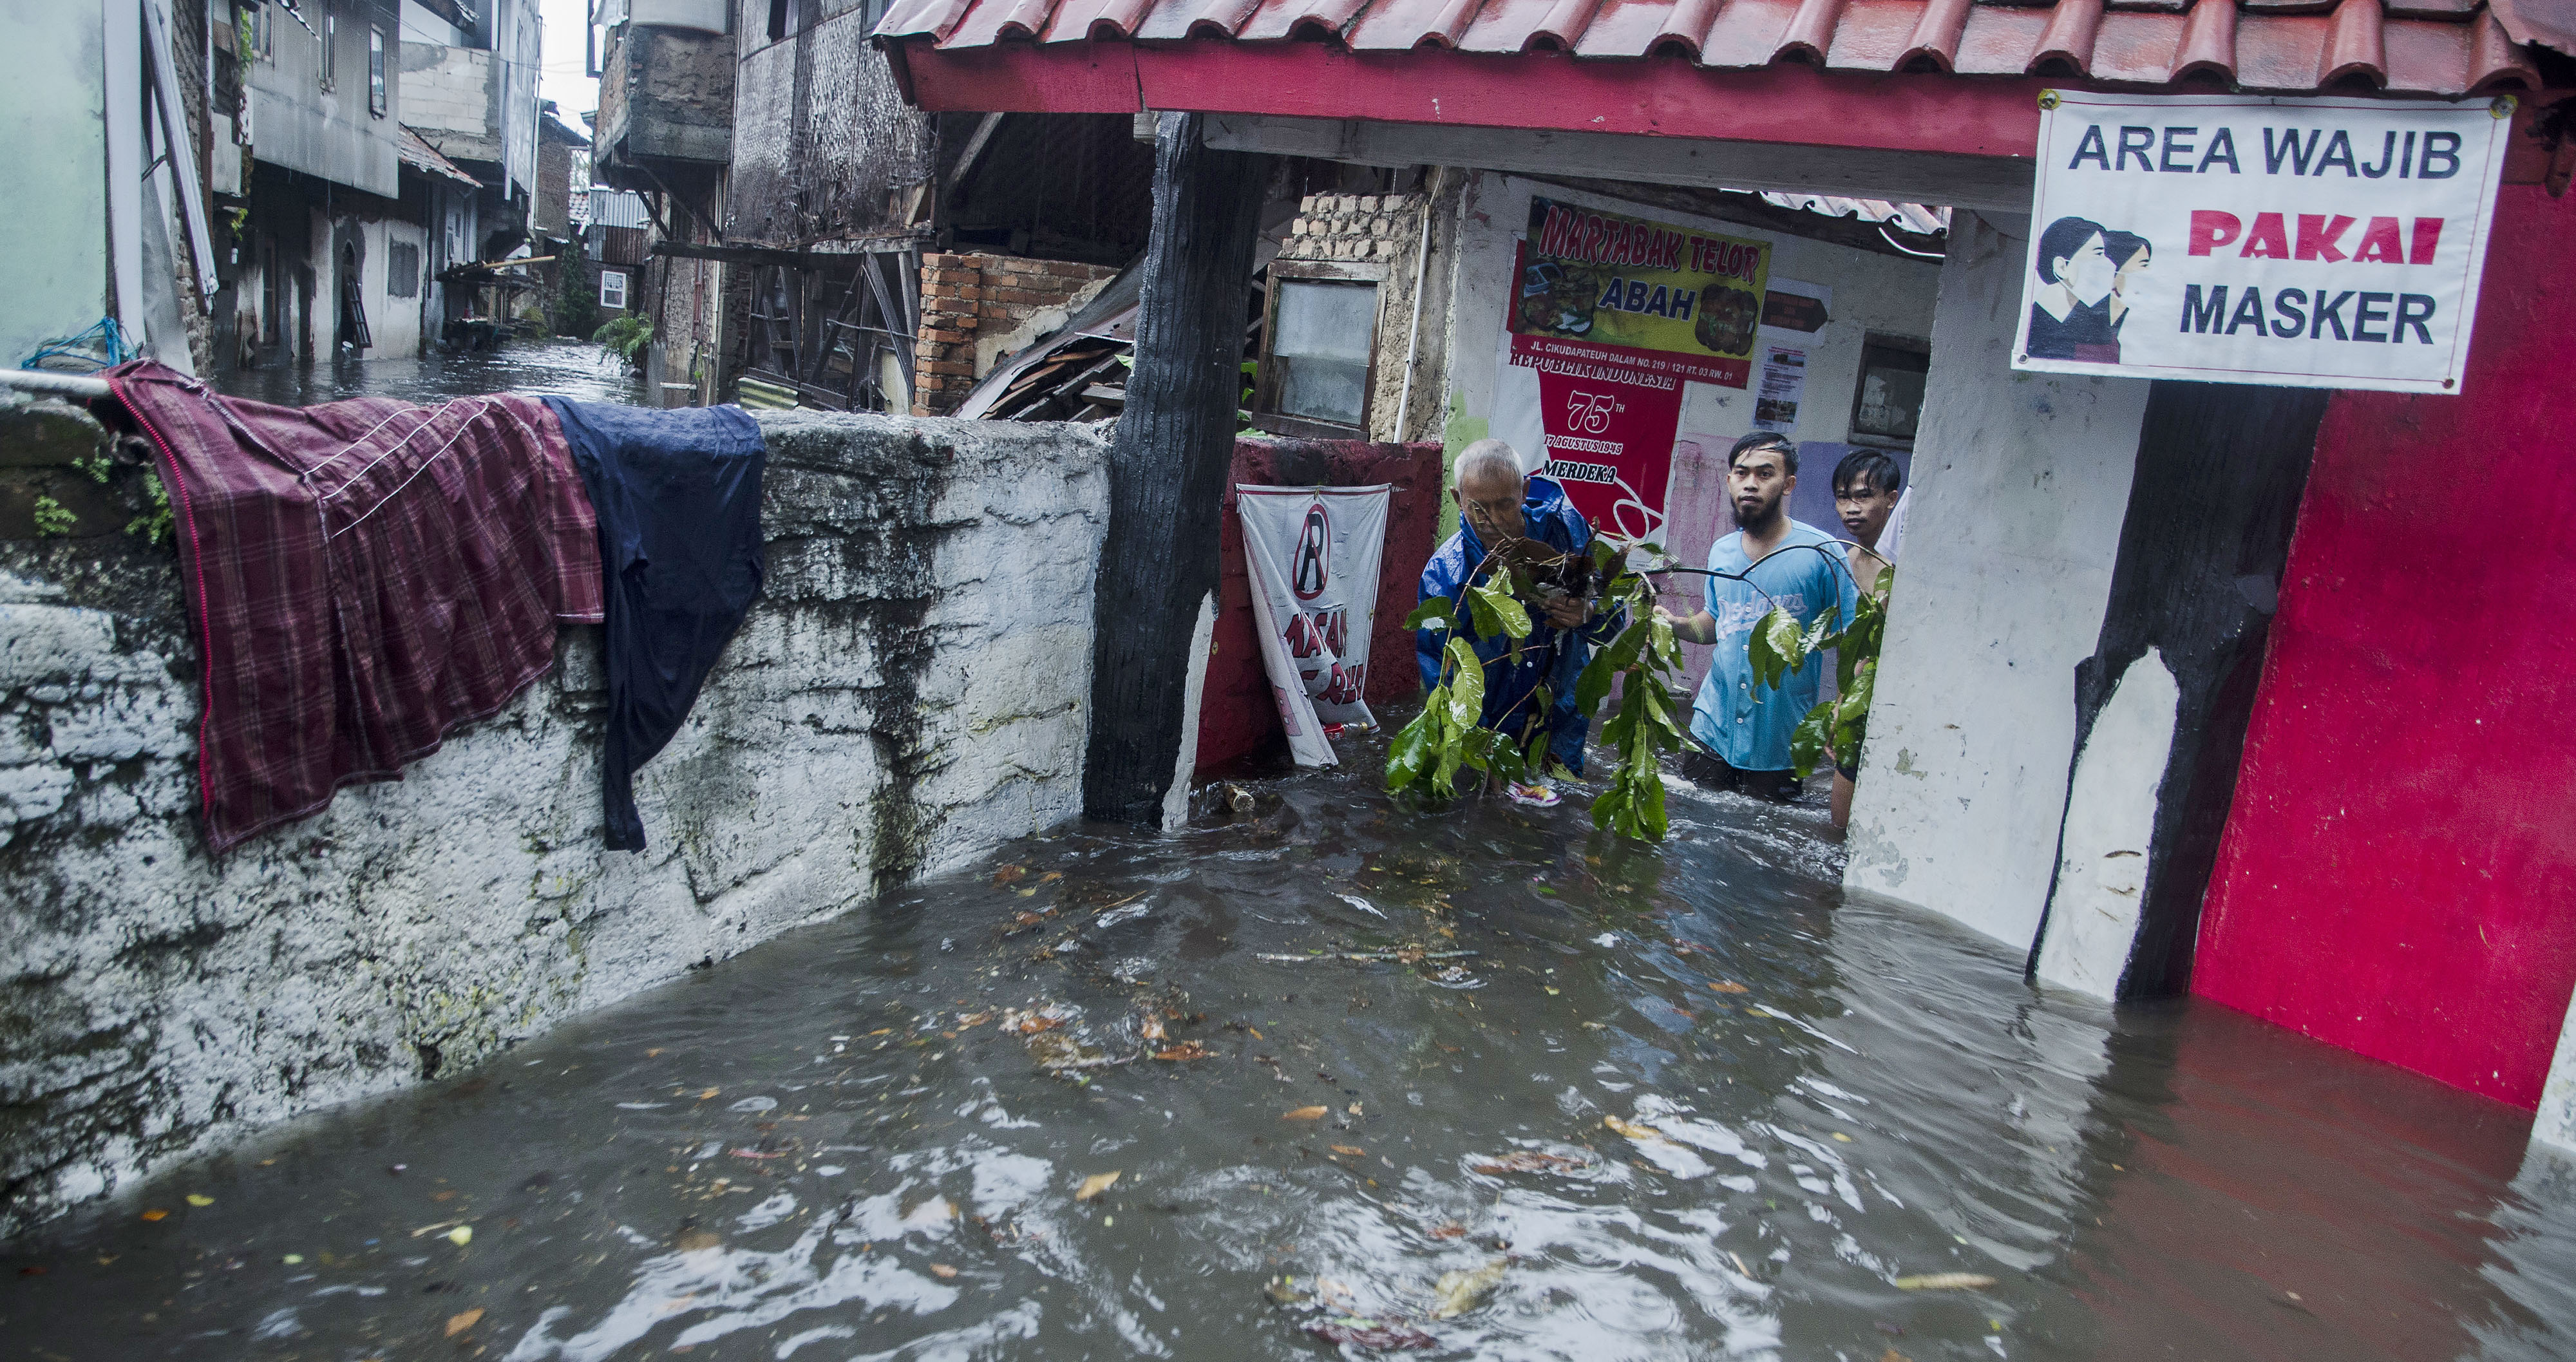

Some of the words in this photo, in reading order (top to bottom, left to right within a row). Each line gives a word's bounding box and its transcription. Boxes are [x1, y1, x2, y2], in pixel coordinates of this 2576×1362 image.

[2068, 124, 2241, 175] AREA
[2263, 127, 2463, 179] WAJIB
[1538, 205, 1685, 272] MARTABAK
[1689, 235, 1760, 285] TELOR
[2188, 209, 2445, 265] PAKAI
[1598, 277, 1698, 322] ABAH
[2179, 283, 2434, 345] MASKER
[1510, 353, 1592, 379] REPUBLIK
[1530, 341, 1543, 352] JL.
[1545, 343, 1608, 361] CIKUDAPATEUH
[1609, 353, 1635, 366] DALAM
[1637, 357, 1651, 368] NO.
[1652, 360, 1666, 370] 219
[1666, 363, 1671, 371] /
[1672, 363, 1685, 374] 121
[1686, 365, 1697, 375] RT.
[1698, 368, 1709, 377] 03
[1709, 369, 1722, 379] RW.
[1724, 372, 1732, 381] 01
[1567, 390, 1615, 434] 75
[1615, 403, 1625, 413] TH
[1544, 433, 1556, 447] 17
[1555, 435, 1599, 452] AGUSTUS
[1599, 441, 1624, 455] 1945
[1541, 460, 1618, 484] MERDEKA
